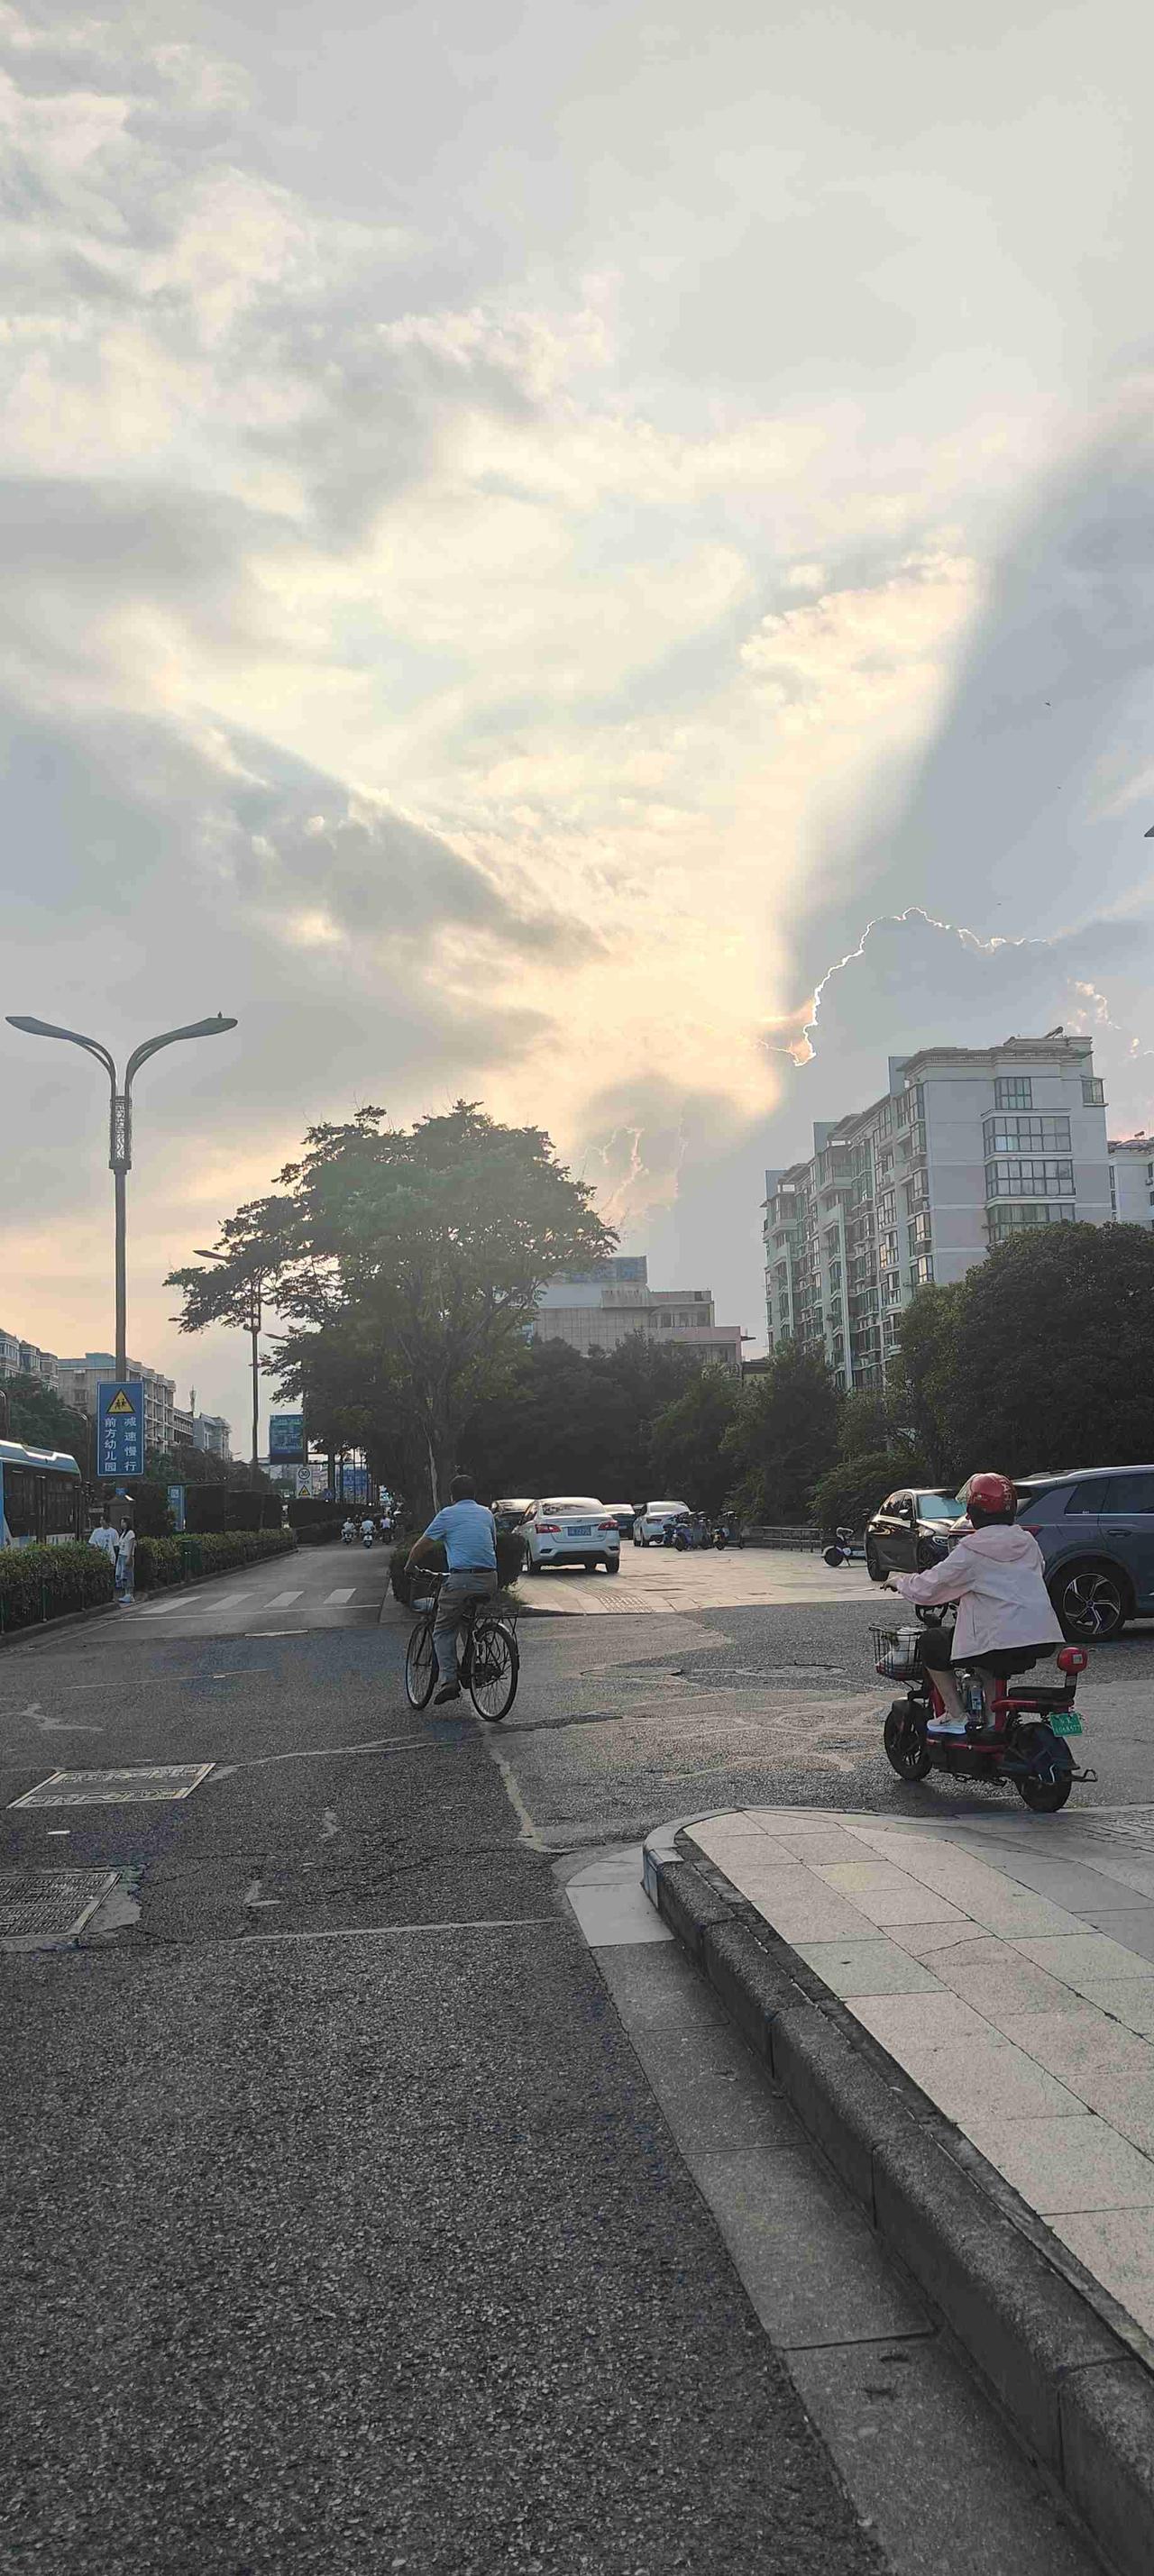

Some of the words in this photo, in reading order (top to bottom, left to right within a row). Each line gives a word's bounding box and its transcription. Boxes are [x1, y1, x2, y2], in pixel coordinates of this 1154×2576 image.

[105, 1417, 117, 1472] 前方幼儿园
[124, 1416, 137, 1472] 减速慢行
